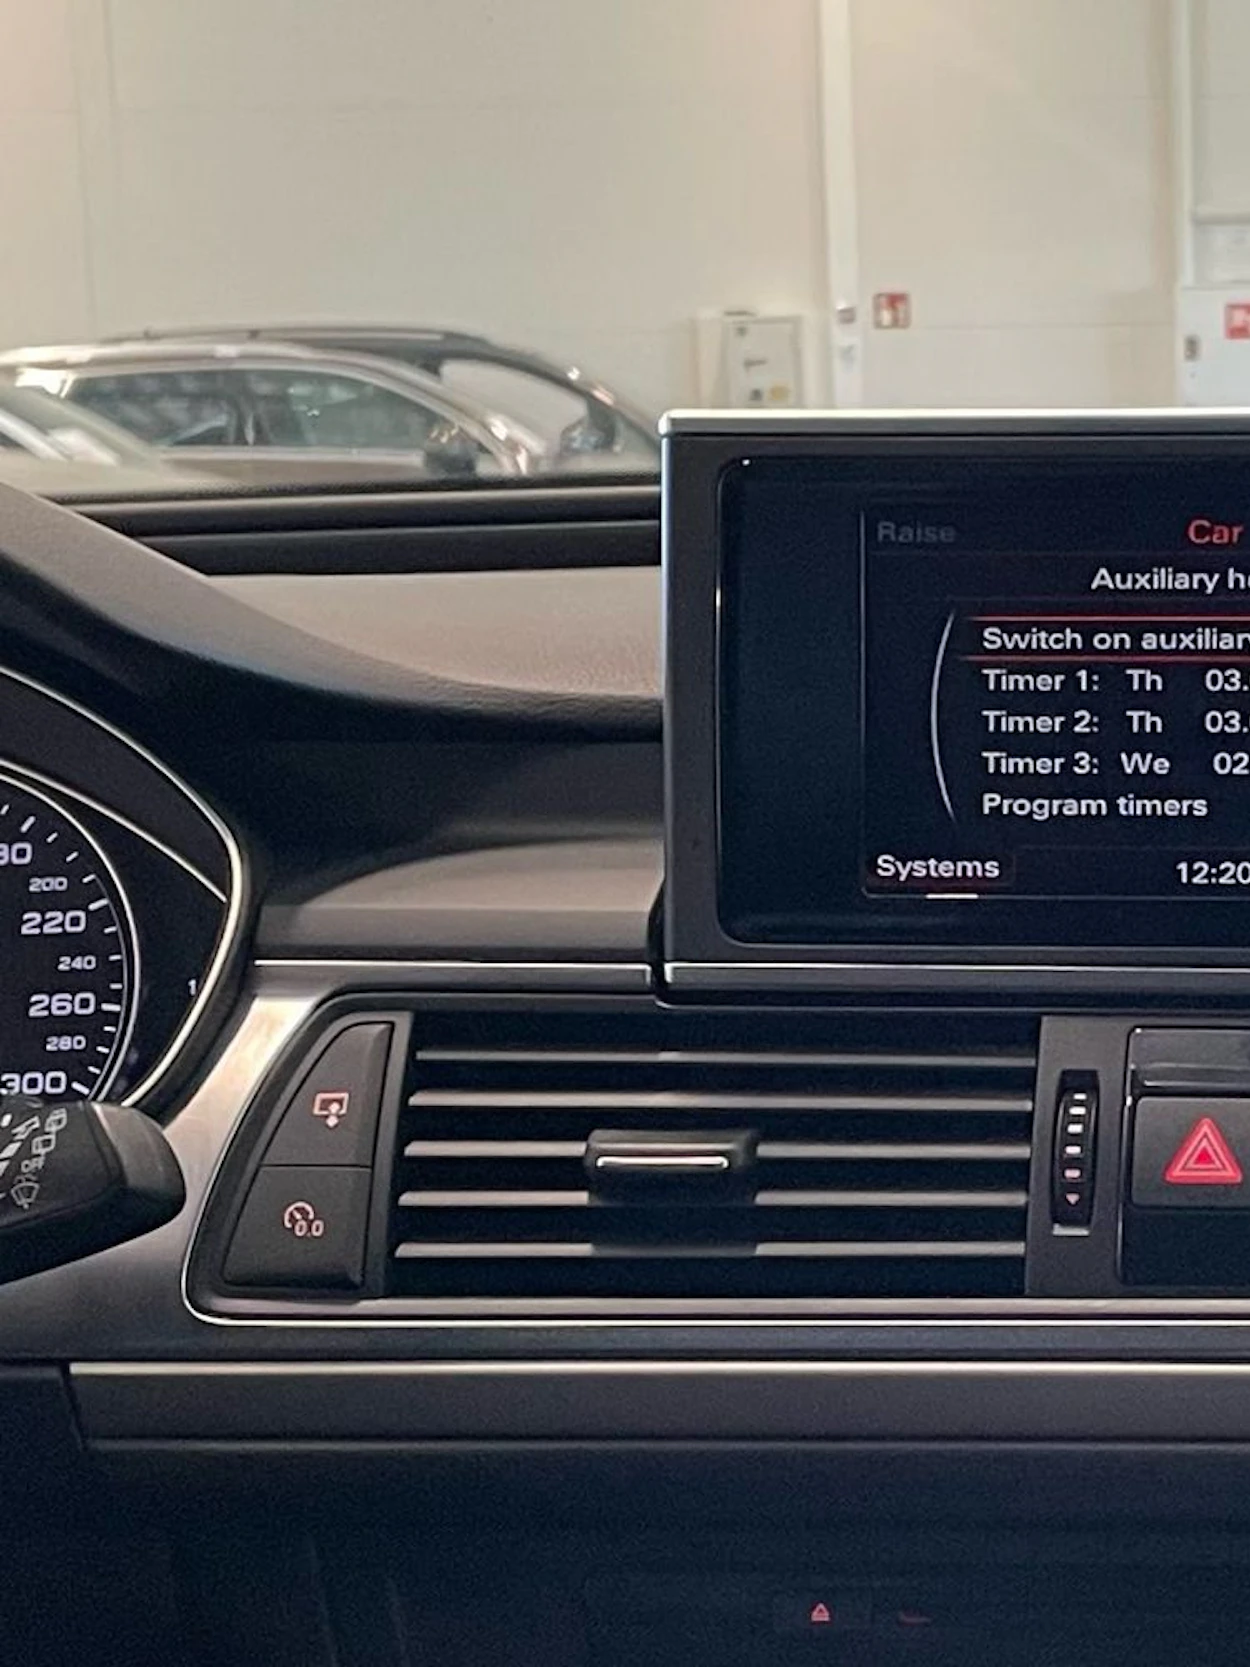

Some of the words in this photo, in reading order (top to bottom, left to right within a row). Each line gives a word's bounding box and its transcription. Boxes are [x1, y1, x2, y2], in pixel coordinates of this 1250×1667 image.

[877, 520, 956, 545] Raise
[1187, 519, 1243, 545] Car
[1090, 566, 1220, 595] Auxiliary
[980, 626, 1083, 651] Switch
[1092, 632, 1132, 651] on
[981, 668, 1066, 692] Timer
[1075, 668, 1100, 692] 1:
[1125, 668, 1164, 692] Th
[981, 709, 1066, 734] Timer
[1073, 709, 1100, 734] 2:
[1125, 709, 1164, 734] Th
[981, 751, 1066, 775] Timer
[1073, 751, 1100, 775] 3:
[1120, 751, 1171, 775] We
[982, 791, 1108, 821] Program
[1116, 793, 1208, 818] timers
[877, 854, 1001, 883] Systems
[28, 876, 69, 892] 200
[20, 910, 87, 935] 220
[57, 955, 97, 971] 240
[28, 992, 96, 1017] 260
[45, 1035, 87, 1052] 280
[0, 1070, 67, 1096] 300
